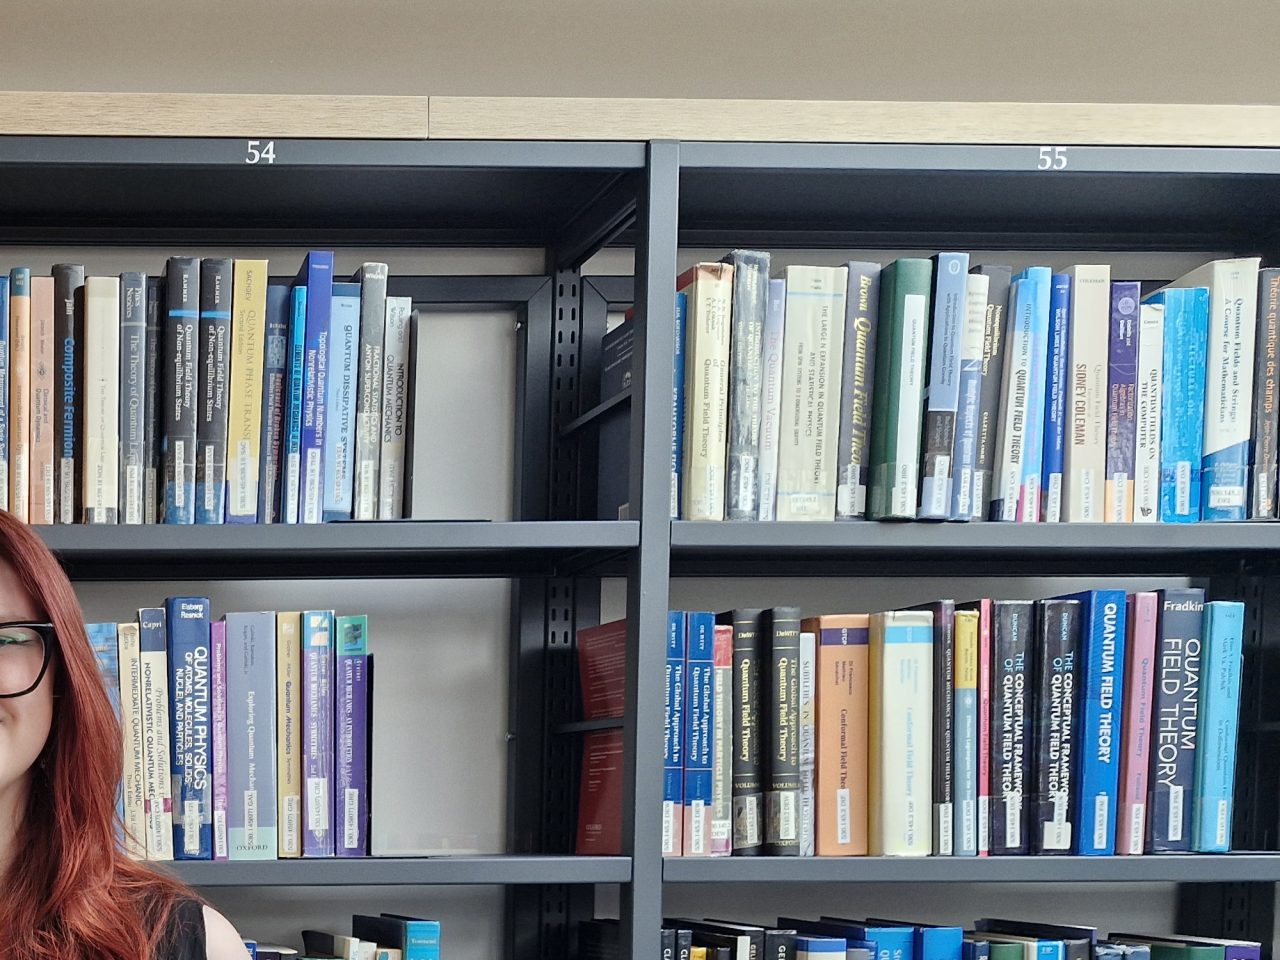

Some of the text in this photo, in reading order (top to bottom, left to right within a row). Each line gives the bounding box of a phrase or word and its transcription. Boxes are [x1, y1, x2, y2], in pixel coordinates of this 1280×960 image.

[245, 140, 276, 164] 54
[1037, 147, 1068, 170] 55
[1264, 277, 1279, 413] Théorie quantique des champs
[385, 355, 393, 442] QUANTUM MECHANICS
[395, 363, 404, 435] INTRODUCTION TO
[1010, 369, 1027, 464] QUANTUM FIELD THEORY
[1074, 364, 1086, 445] SIDNEY COLEMAN
[1163, 601, 1203, 611] Fradkin
[194, 647, 207, 789] QUANTUM PHYSICS
[1099, 603, 1116, 763] QUANTUM FIELD THEORY
[1158, 638, 1180, 786] FIELD THEORY
[1181, 638, 1200, 749] QUANTUM
